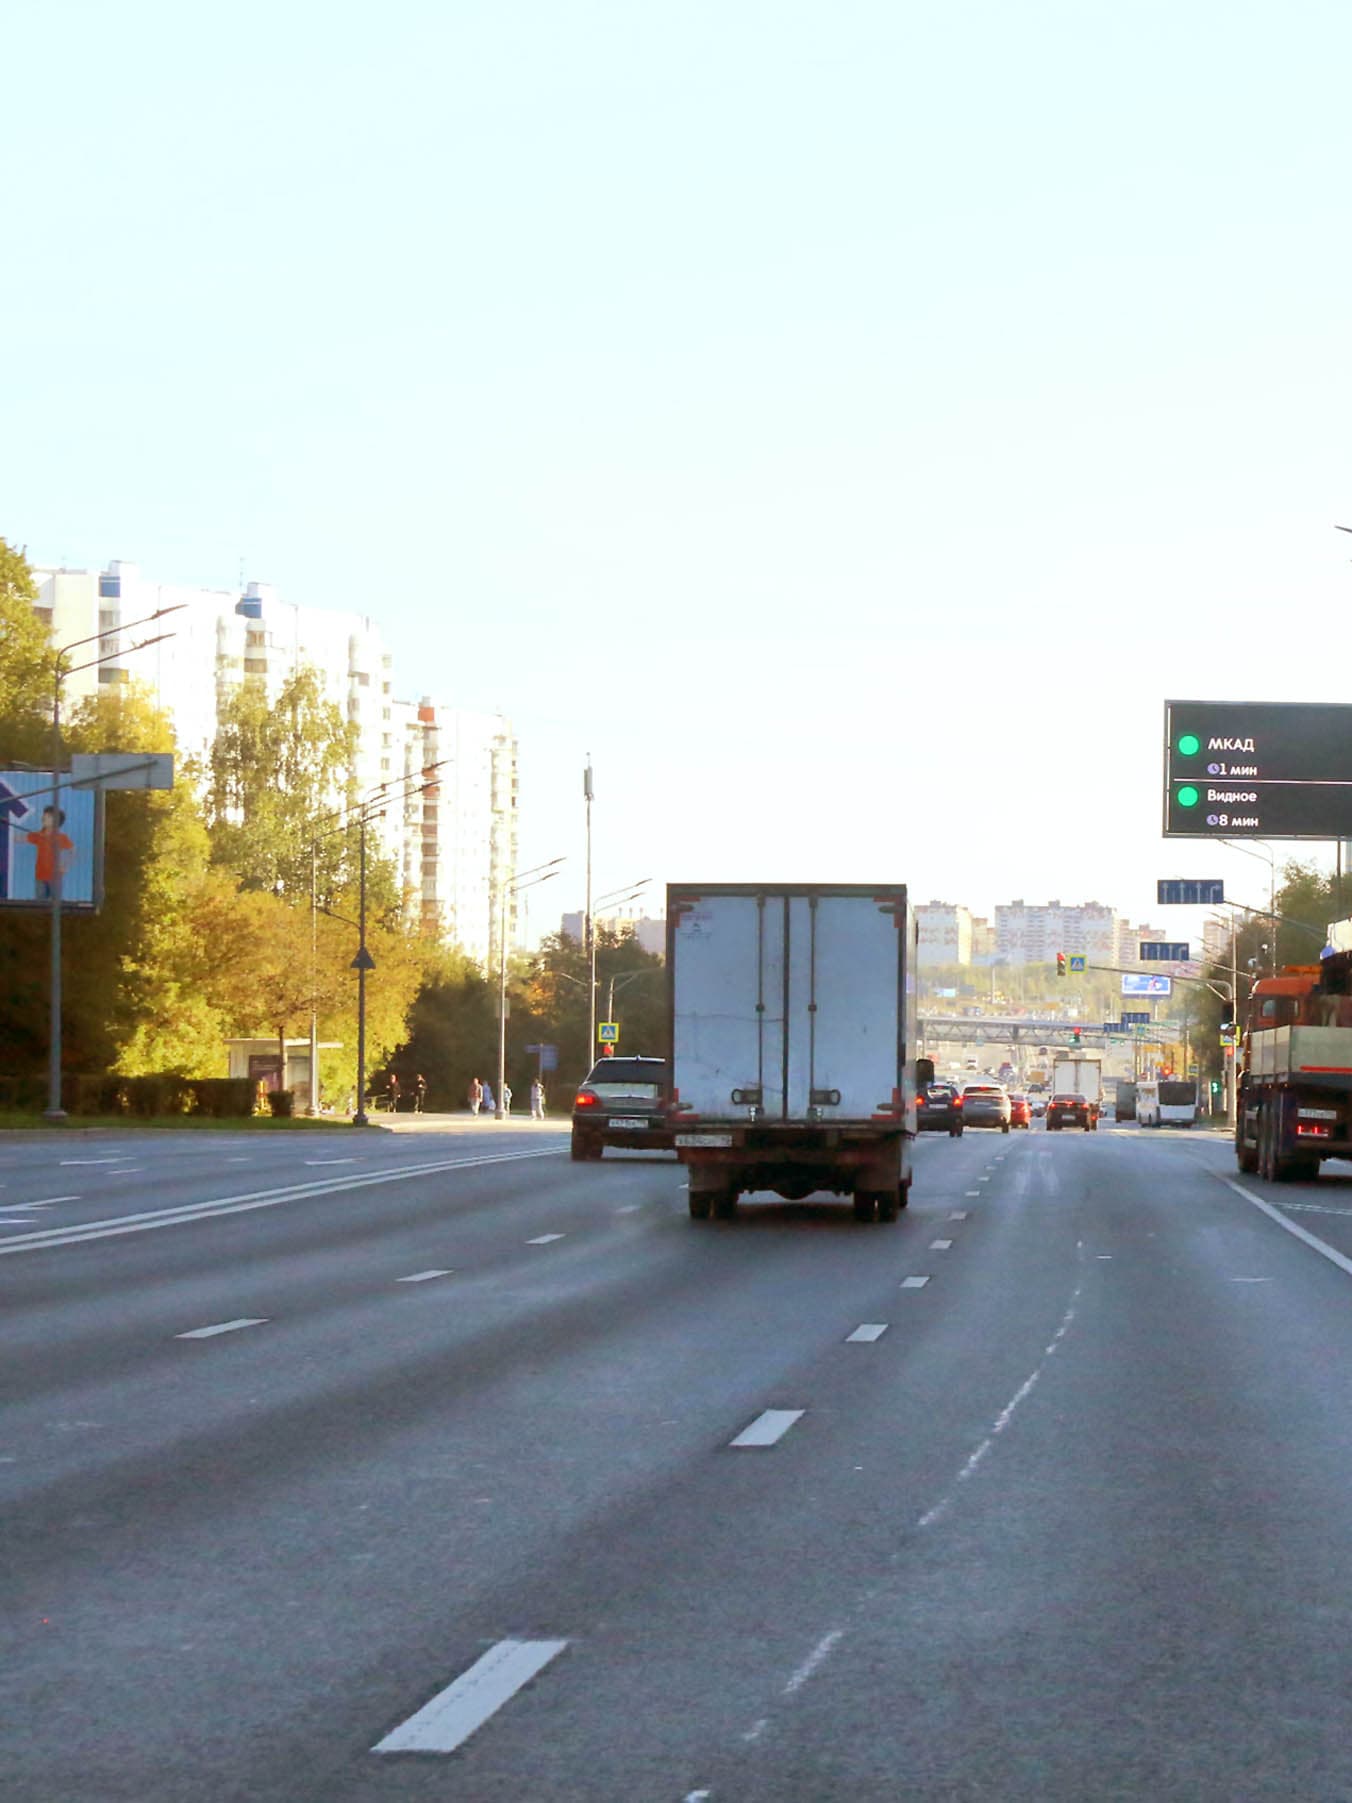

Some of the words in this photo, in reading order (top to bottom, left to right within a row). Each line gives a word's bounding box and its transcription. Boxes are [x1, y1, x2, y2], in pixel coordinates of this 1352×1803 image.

[1208, 738, 1255, 752] МКАД
[1220, 763, 1227, 775] 1
[1230, 766, 1258, 776] мин
[1207, 789, 1257, 803] Видное
[1218, 814, 1228, 826] 8
[1231, 818, 1259, 827] мин
